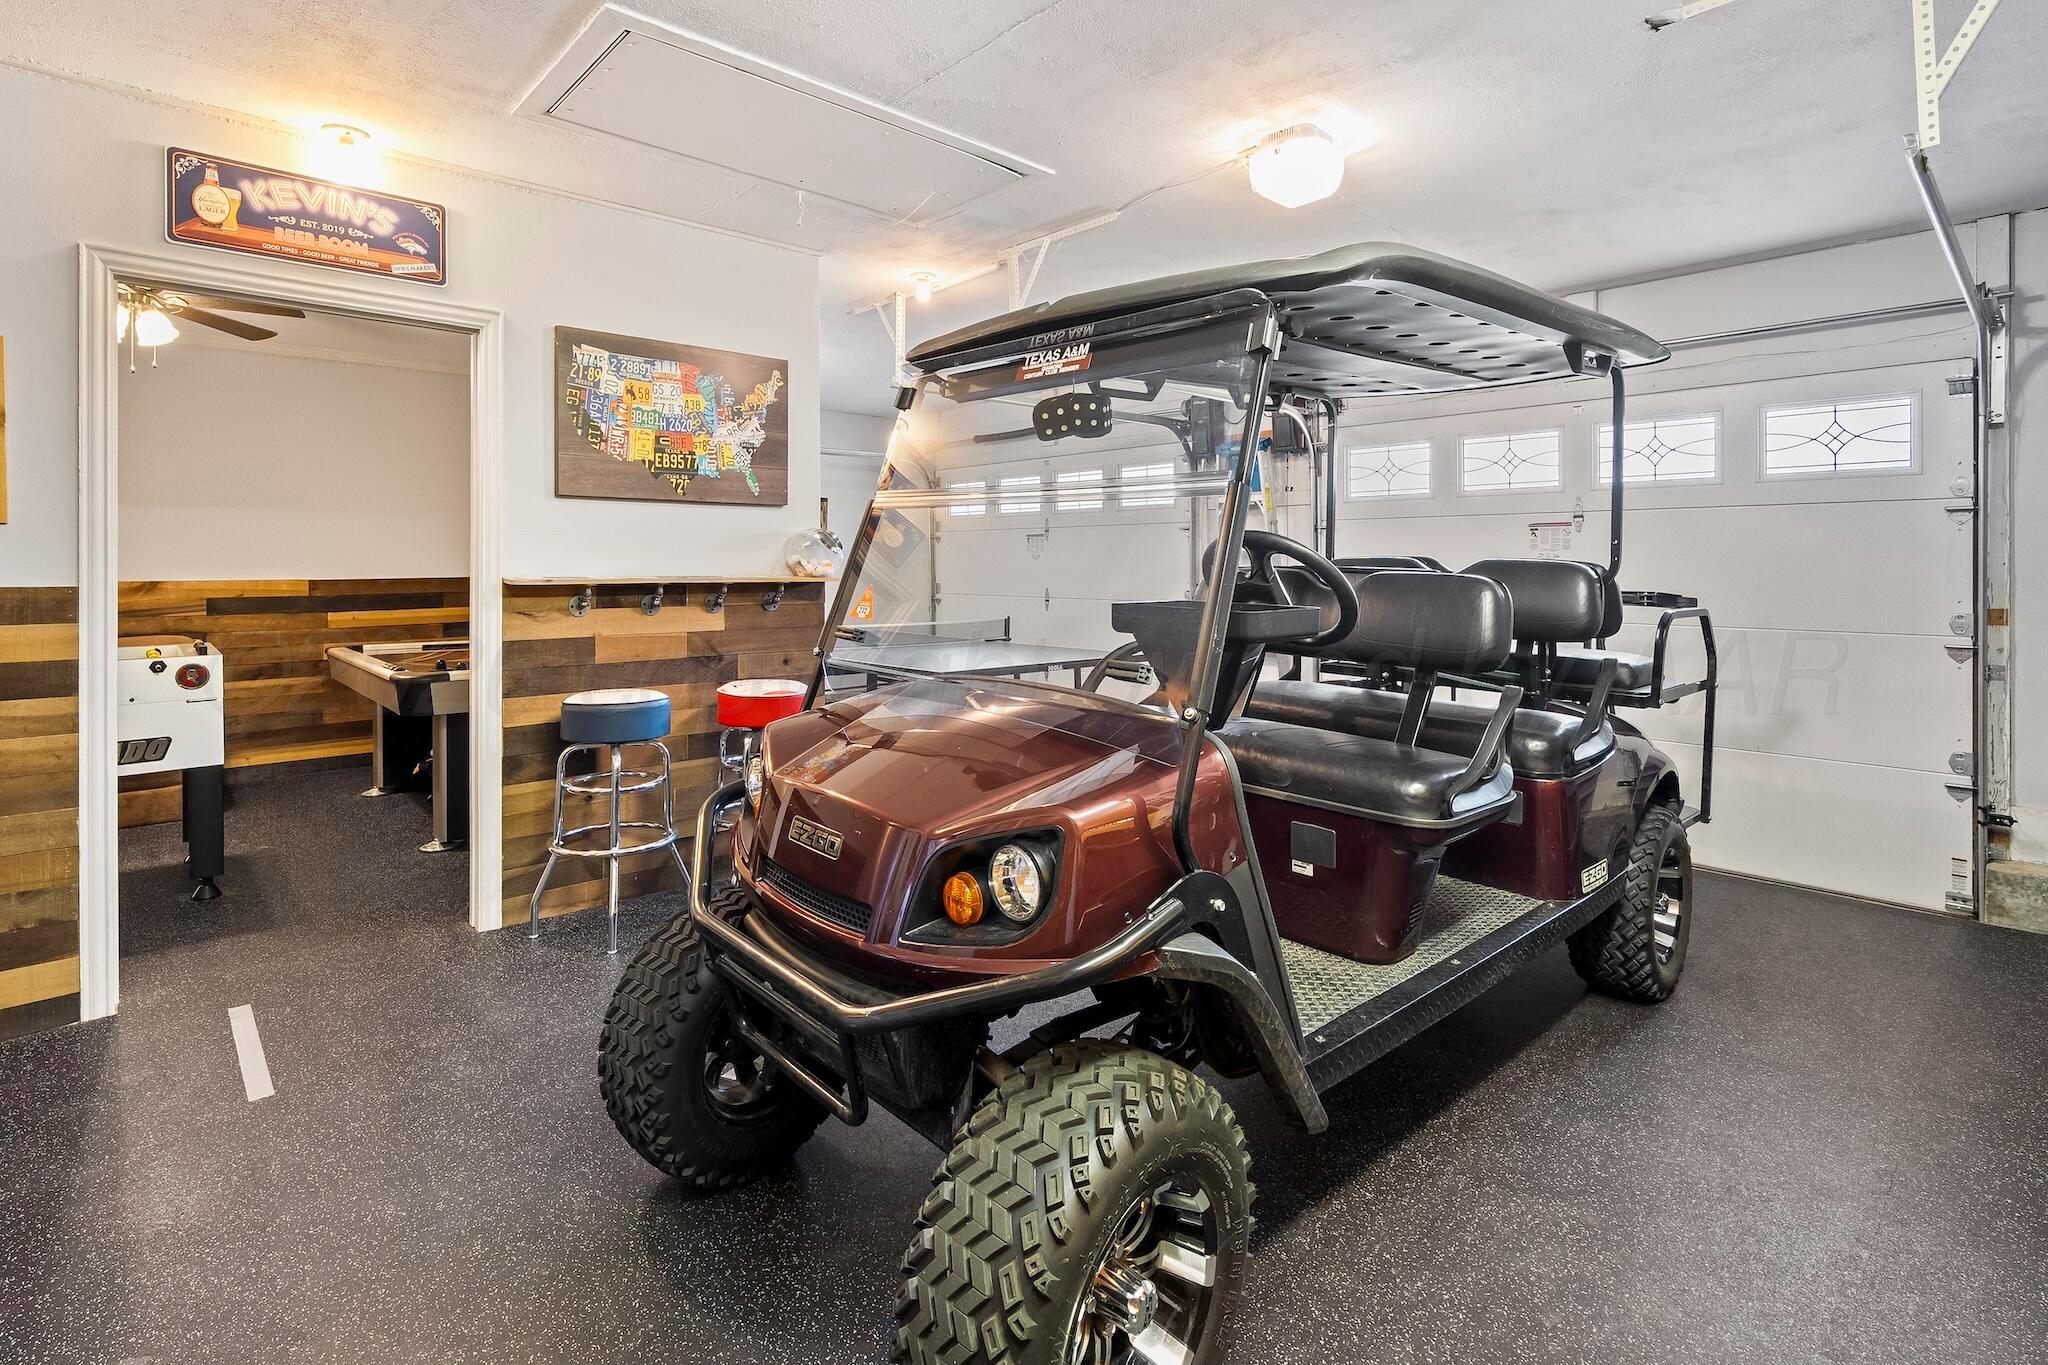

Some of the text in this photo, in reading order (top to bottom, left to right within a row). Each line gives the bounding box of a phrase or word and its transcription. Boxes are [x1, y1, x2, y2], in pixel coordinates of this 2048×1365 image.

[240, 180, 397, 235] KEVIN'S
[300, 218, 345, 235] EST. 2019
[262, 242, 280, 251] GOOD
[281, 245, 298, 254] TIMES
[302, 249, 320, 258] GOOD
[321, 252, 335, 261] BEER
[339, 255, 356, 264] GREAT
[1024, 342, 1090, 367] TEXAS A&M
